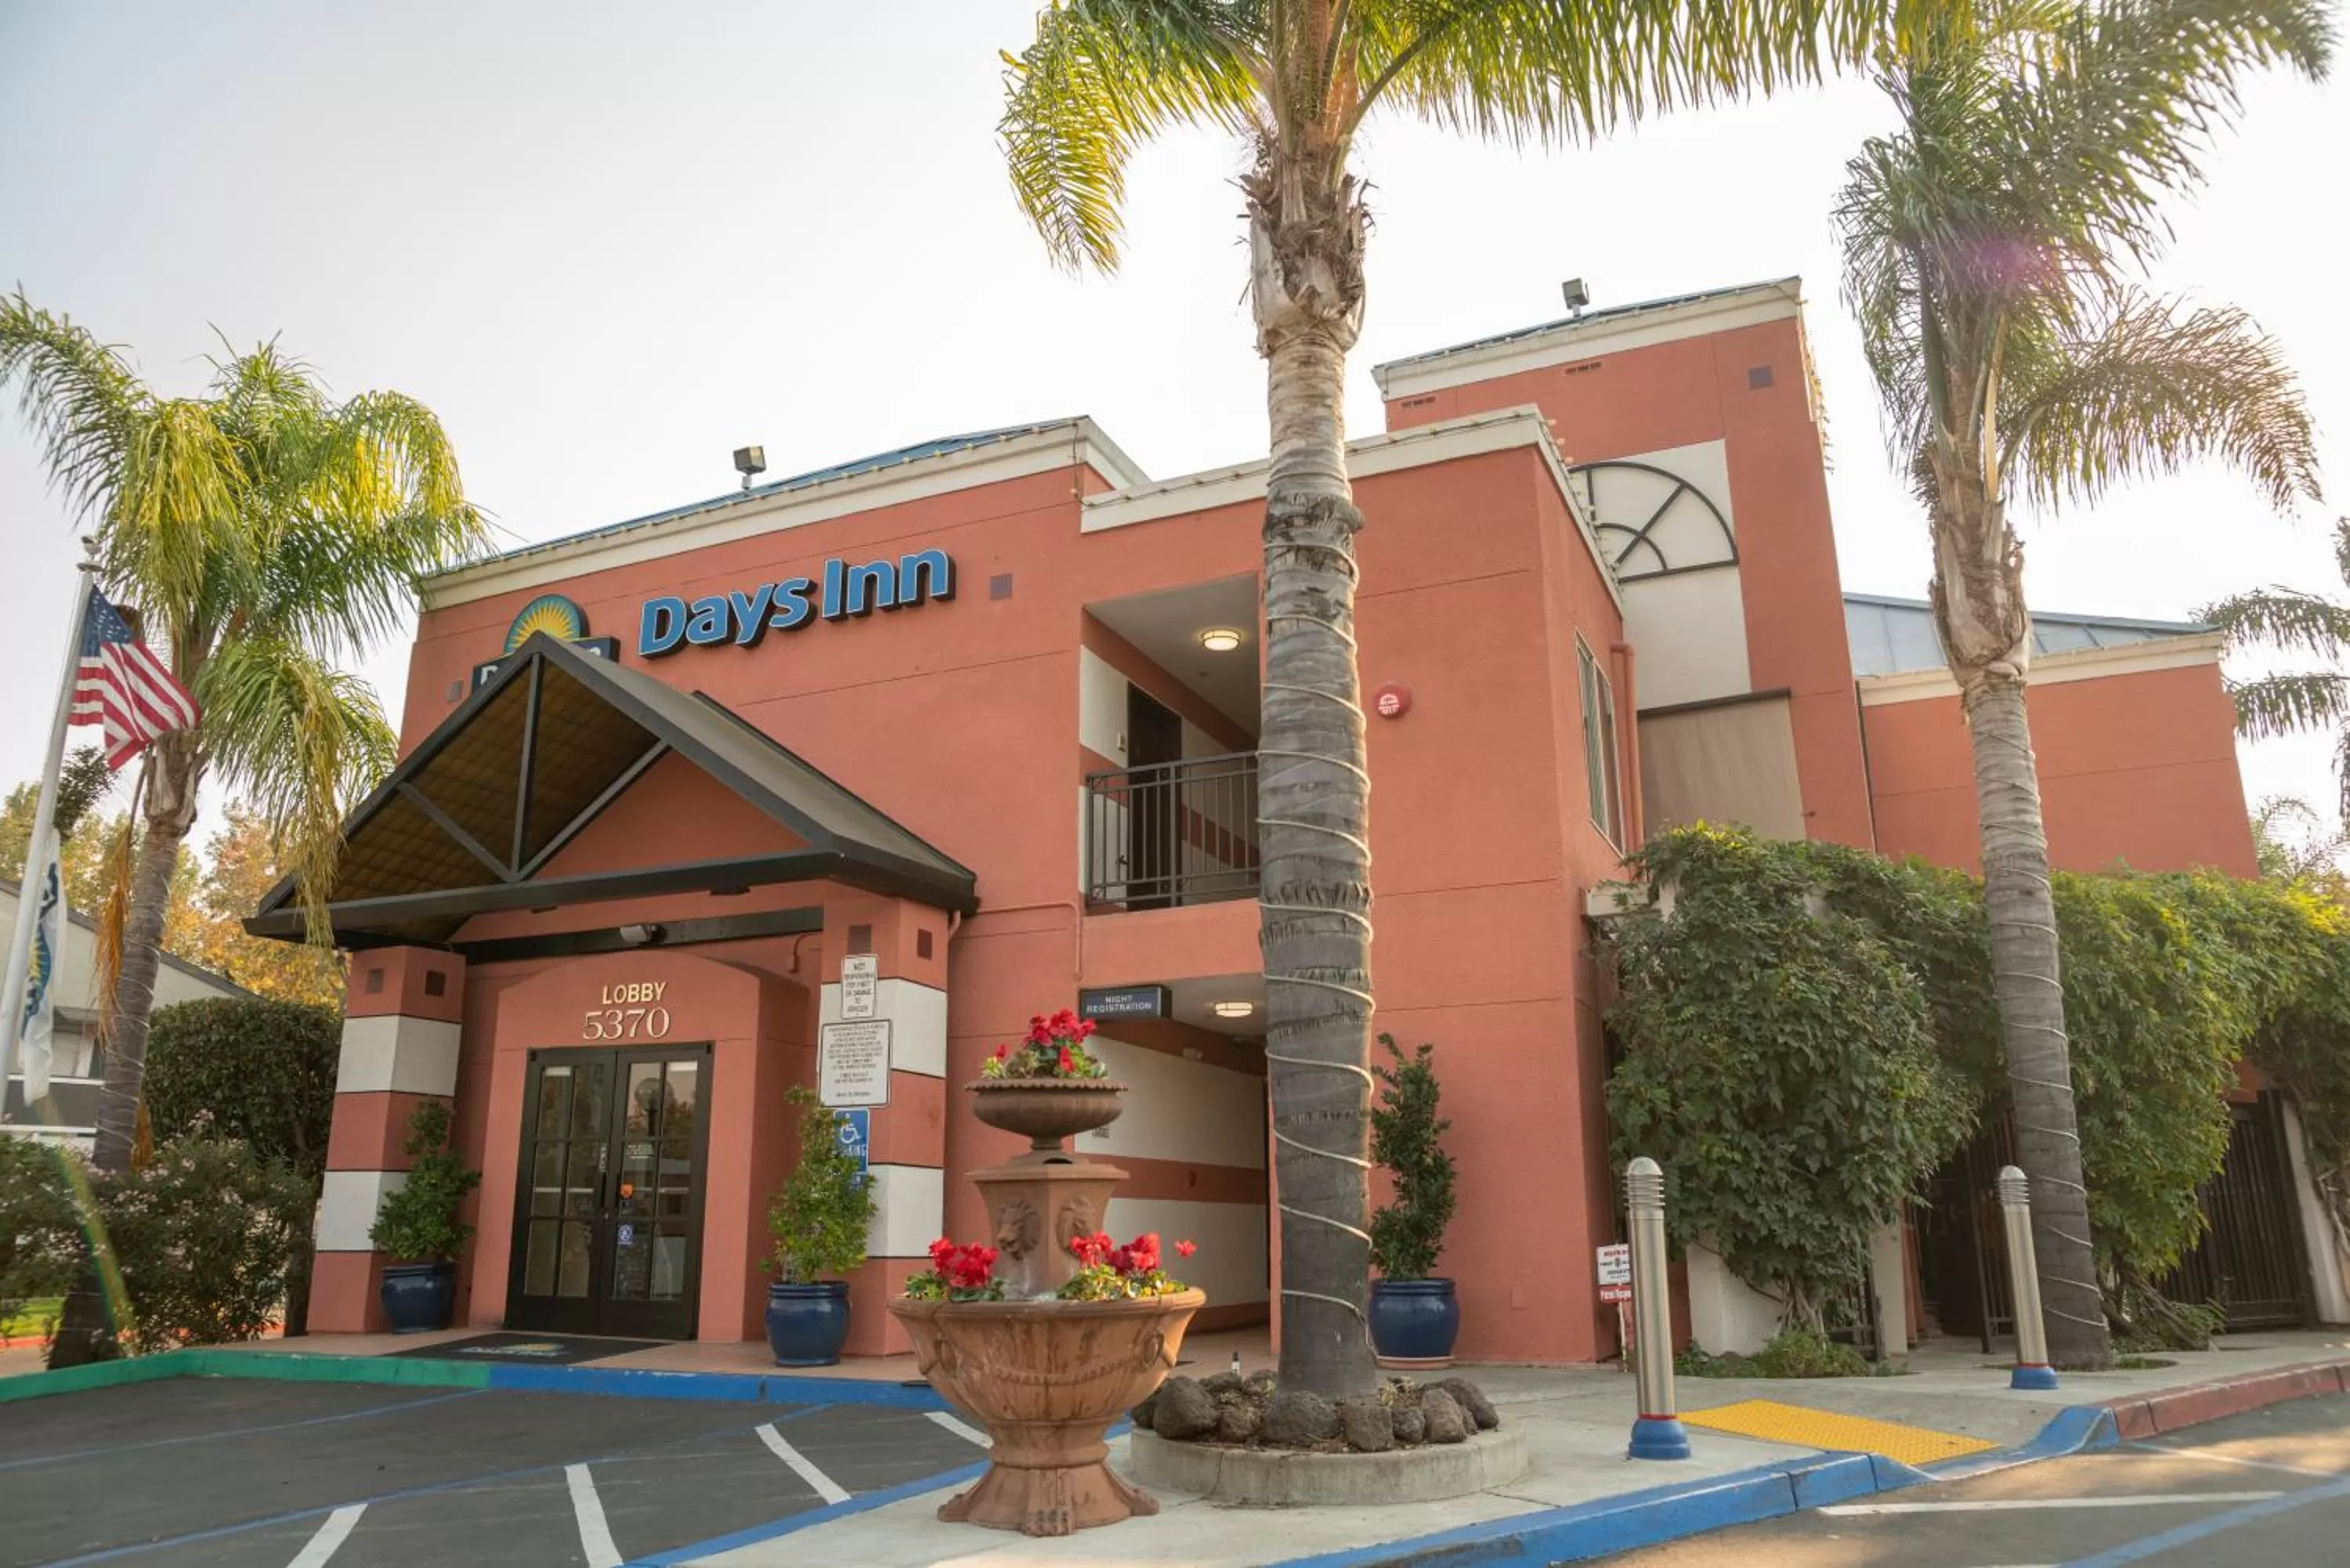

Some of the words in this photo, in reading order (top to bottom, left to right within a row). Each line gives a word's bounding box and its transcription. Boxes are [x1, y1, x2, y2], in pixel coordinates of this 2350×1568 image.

[638, 576, 815, 659] Days
[822, 548, 953, 620] Inn
[602, 981, 667, 1005] LOBBY
[1105, 994, 1133, 1003] NIGHT
[1086, 1002, 1152, 1013] REGISTRATION
[582, 1006, 671, 1040] 5370
